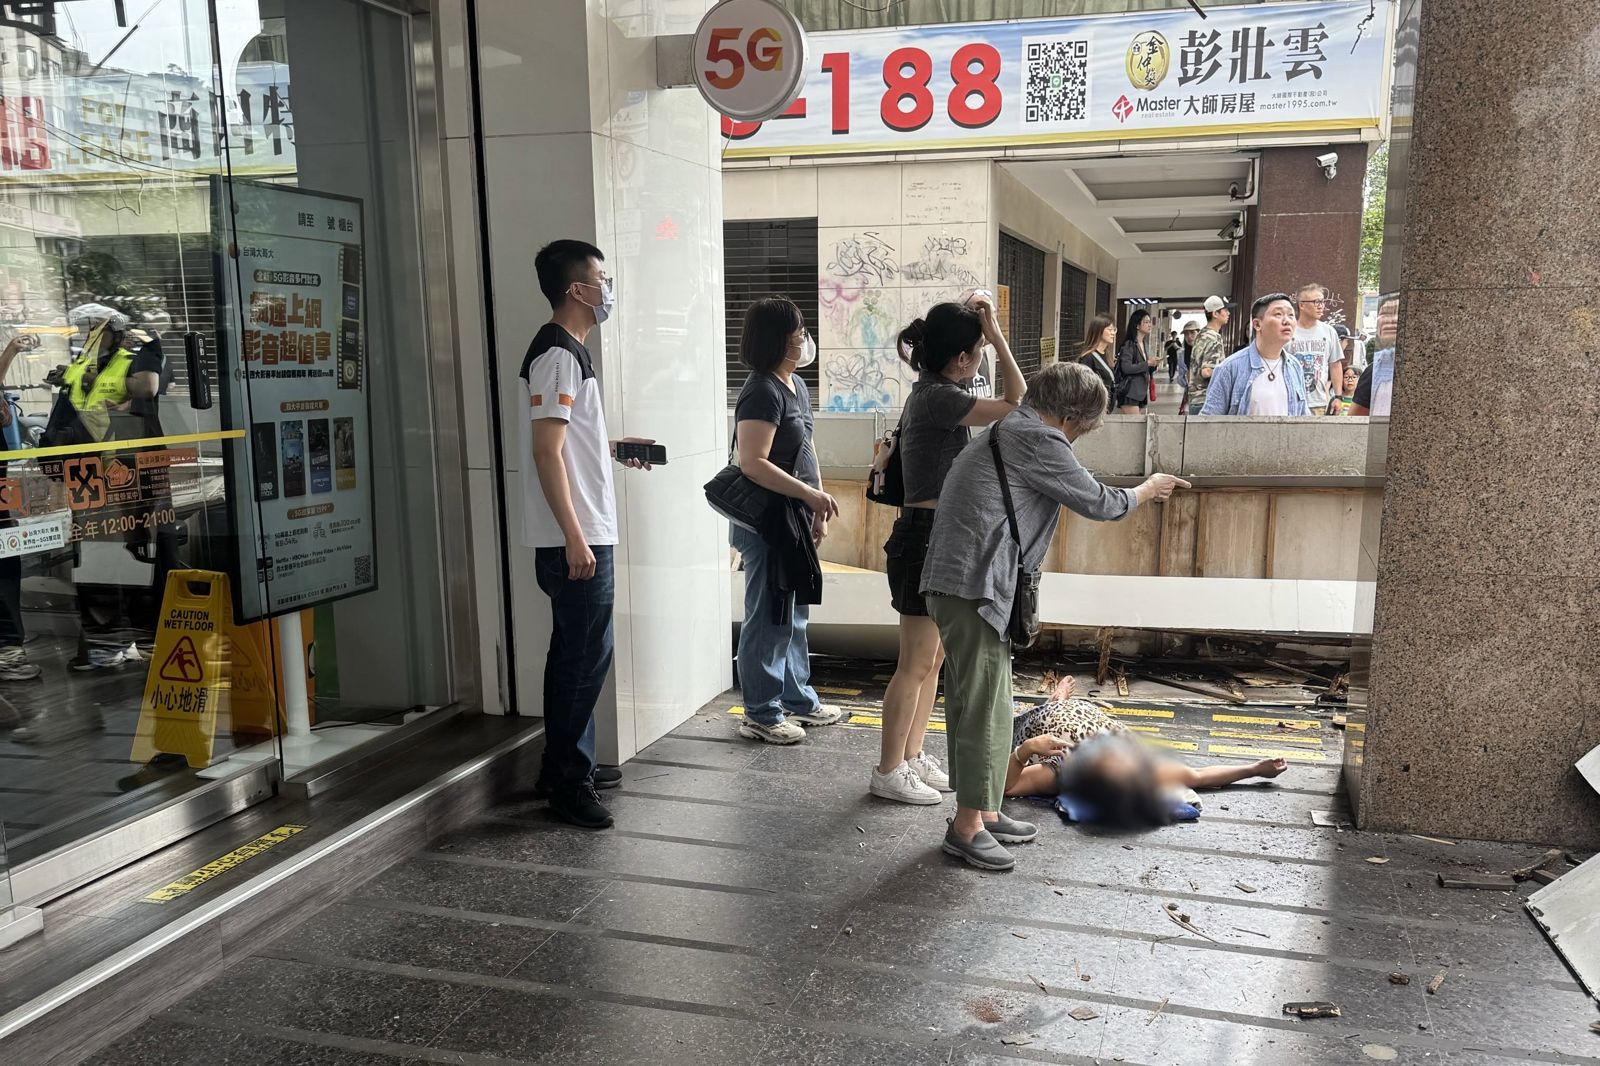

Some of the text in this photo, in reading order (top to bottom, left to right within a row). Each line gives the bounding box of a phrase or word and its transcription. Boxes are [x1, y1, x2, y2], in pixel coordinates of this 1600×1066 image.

[704, 27, 783, 90] 5G
[1177, 22, 1329, 87] 彭壯雲
[721, 42, 1002, 140] -188
[1136, 92, 1256, 116] Master 大師房屋
[1259, 99, 1338, 110] master1995.com.tw
[297, 211, 315, 228] 請至
[243, 246, 274, 259] 台灣大哥大
[100, 508, 176, 535] 12:00~21:00
[164, 619, 214, 632] WET FLOOR
[170, 608, 209, 621] CAUTION
[150, 683, 209, 713] 小心地滑
